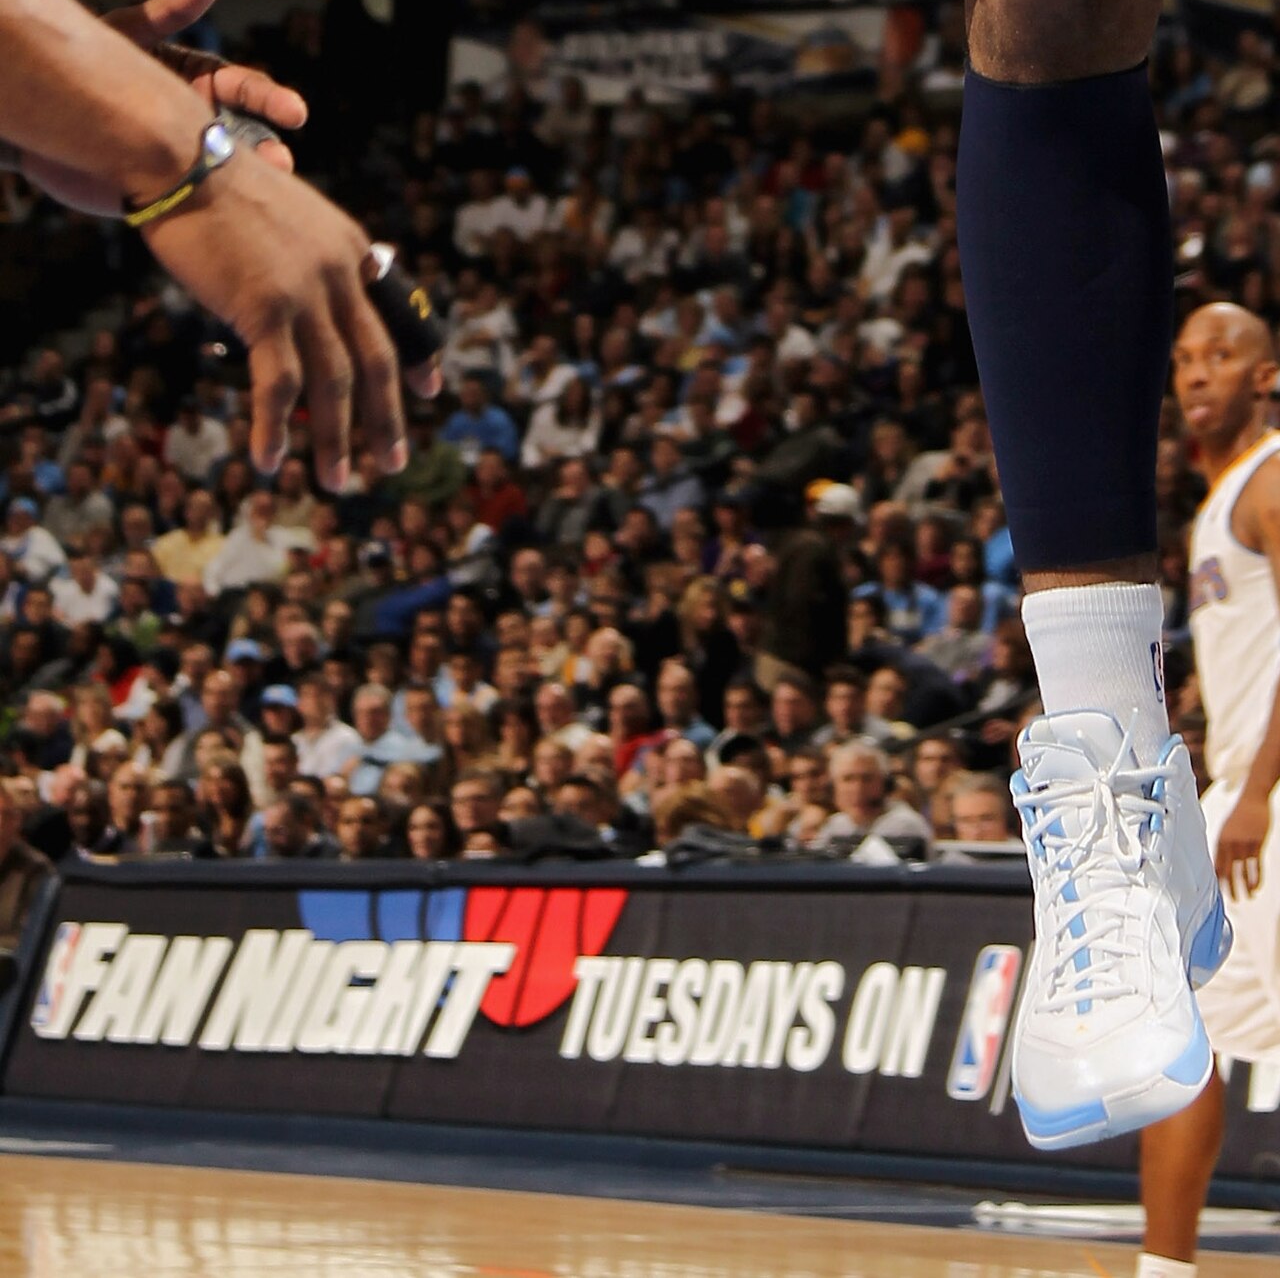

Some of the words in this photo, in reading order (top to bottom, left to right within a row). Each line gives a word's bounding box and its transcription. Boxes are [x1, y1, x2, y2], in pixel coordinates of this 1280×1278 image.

[34, 922, 234, 1047] FAN
[197, 928, 517, 1059] NIGHT
[560, 955, 846, 1072] TUESDAYS
[841, 960, 947, 1078] ON
